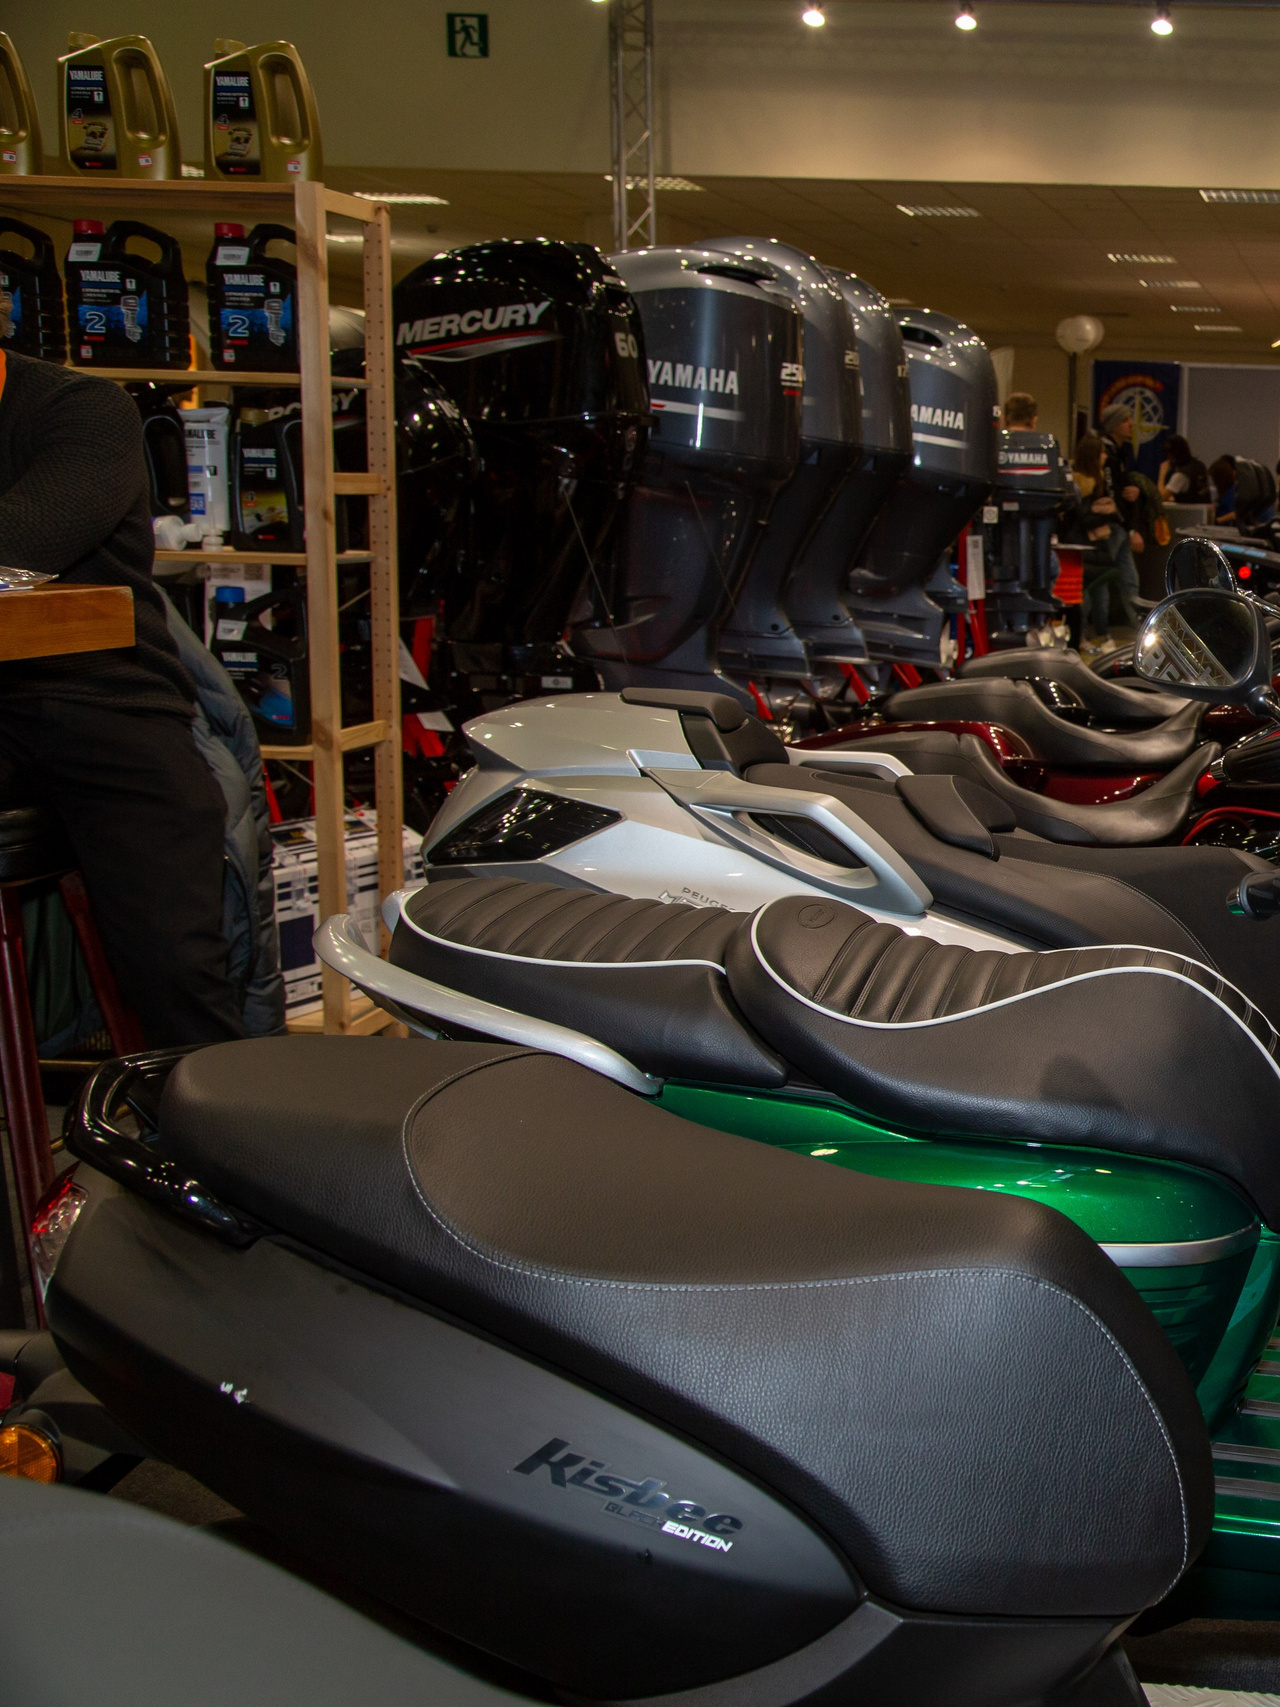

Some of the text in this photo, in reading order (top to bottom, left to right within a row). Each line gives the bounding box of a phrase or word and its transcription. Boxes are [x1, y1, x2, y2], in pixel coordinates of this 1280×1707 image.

[69, 70, 104, 81] YAMALUBE
[215, 76, 250, 87] YAMALUBE
[80, 270, 121, 282] YAMALUBE
[223, 273, 265, 286] YAMALUBE
[85, 311, 106, 333] 2
[228, 315, 250, 337] 2
[396, 300, 554, 346] MERCURY
[613, 332, 639, 359] 60
[648, 358, 740, 396] YAMAHA
[910, 403, 965, 430] AMAHA
[1007, 452, 1048, 465] YAMAHA
[661, 1520, 734, 1553] EDITION
